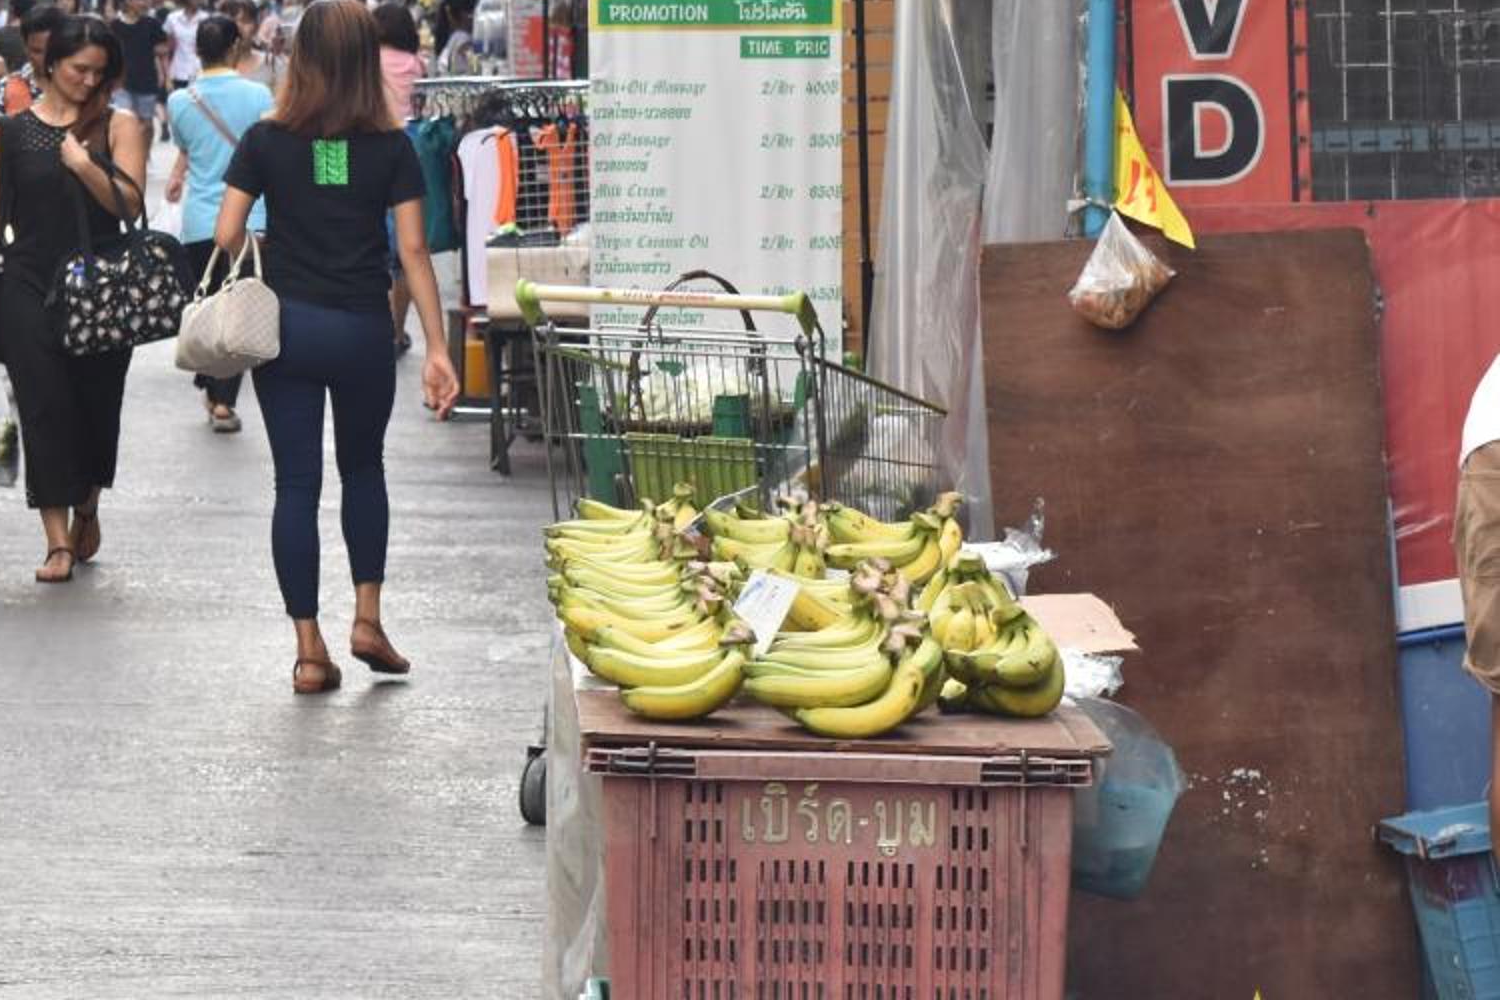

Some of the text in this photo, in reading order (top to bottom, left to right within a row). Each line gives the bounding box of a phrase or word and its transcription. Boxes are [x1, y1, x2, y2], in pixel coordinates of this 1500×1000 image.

[608, 3, 709, 21] PROMOTION
[747, 39, 784, 56] TIME
[741, 782, 936, 857] เบิร์ด-บูม
